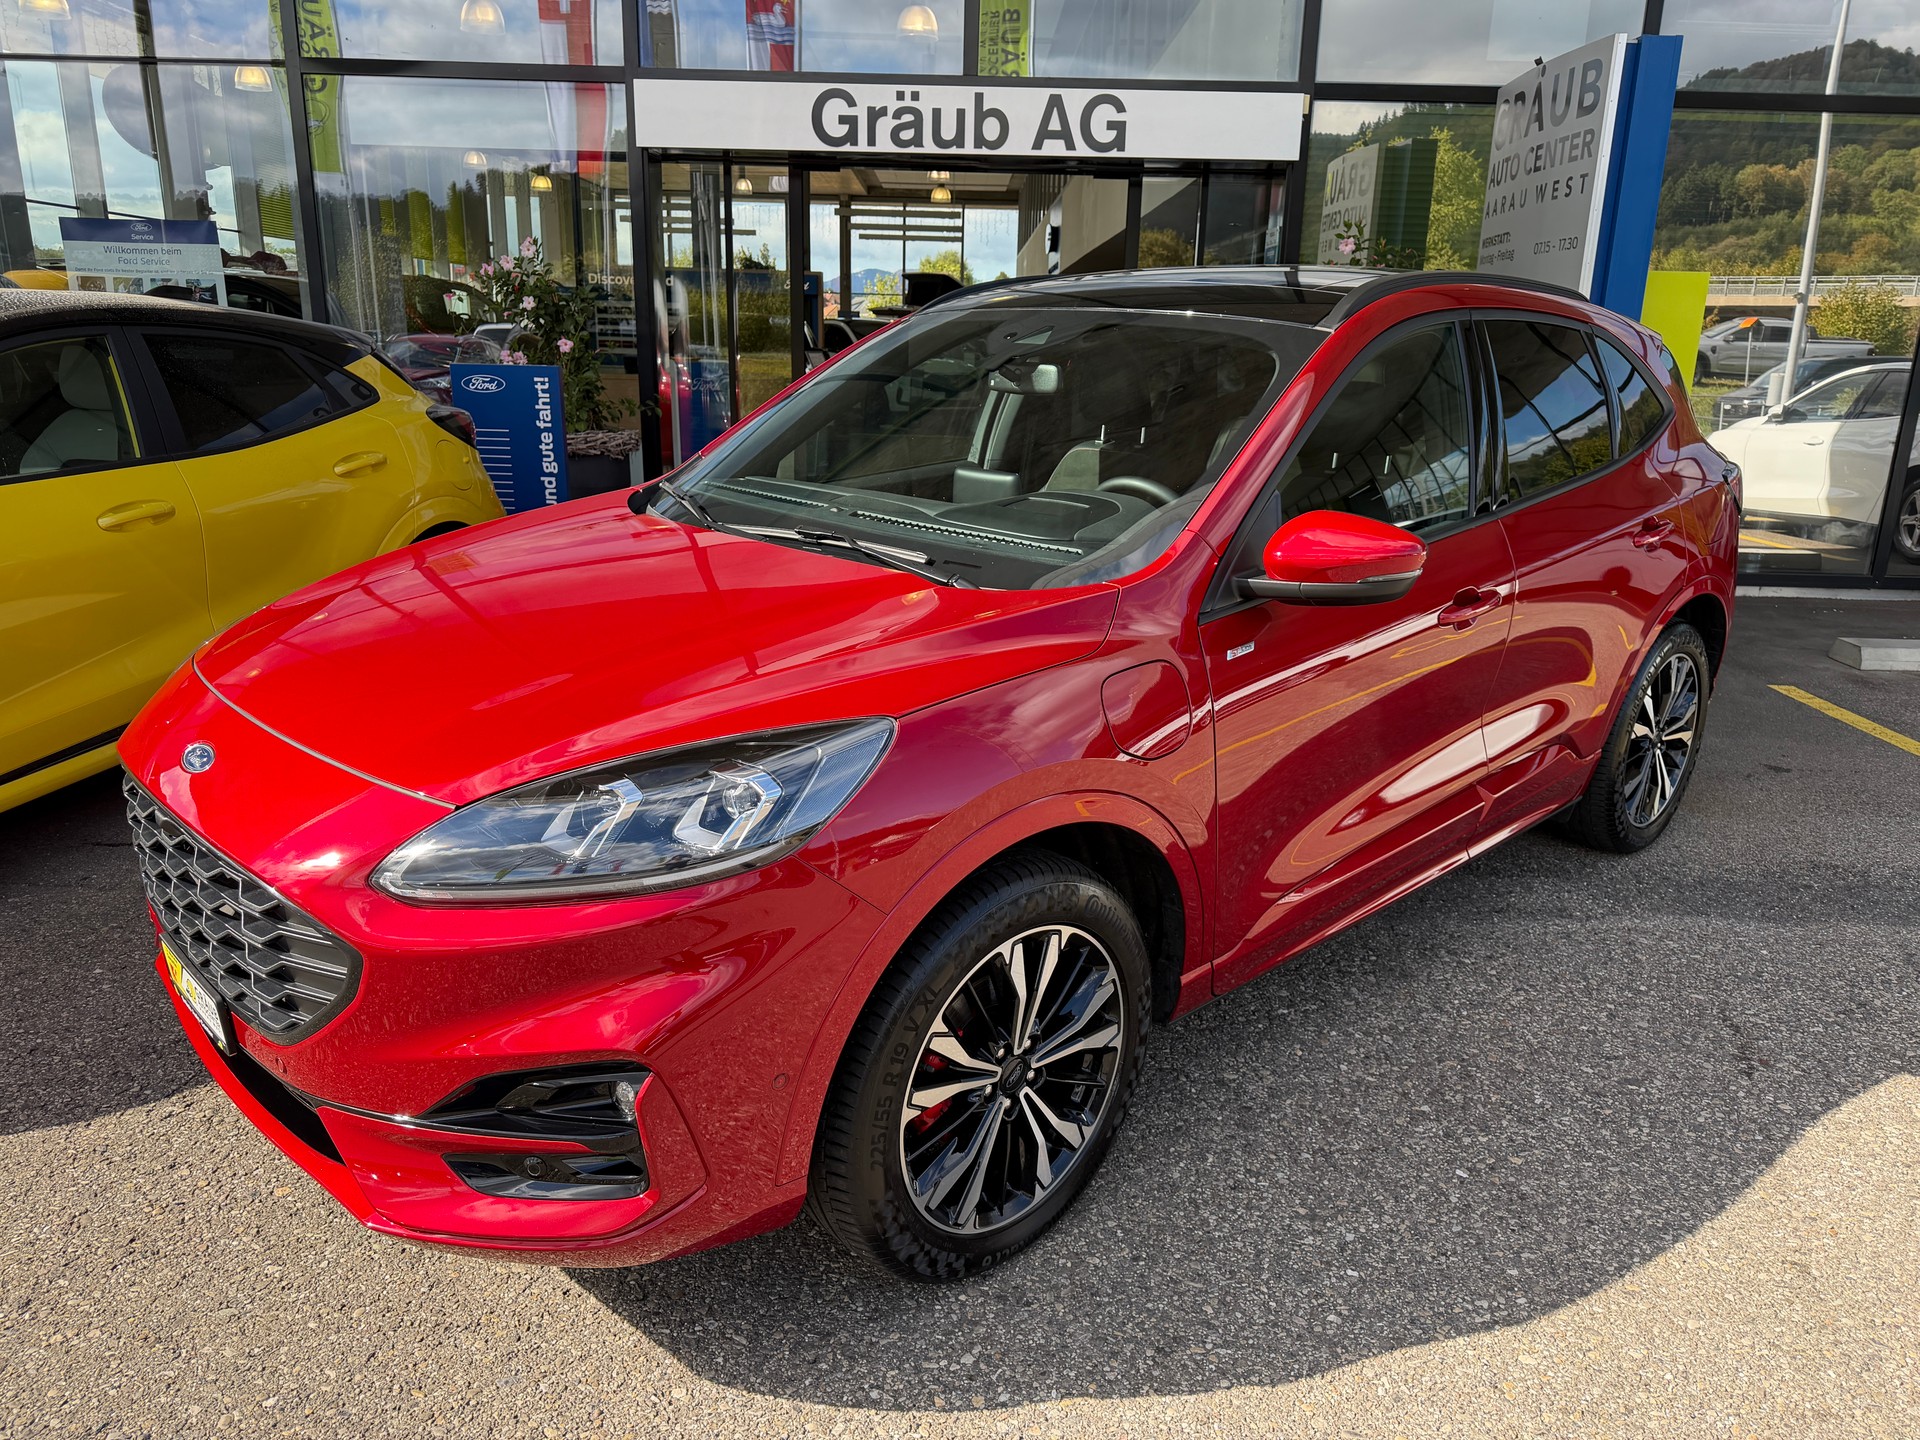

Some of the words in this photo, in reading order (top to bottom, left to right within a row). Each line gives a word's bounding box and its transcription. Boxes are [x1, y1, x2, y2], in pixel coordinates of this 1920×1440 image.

[1494, 58, 1603, 151] GRÄUB
[811, 87, 1010, 150] Gräub
[1031, 93, 1127, 153] AG
[1488, 152, 1521, 190] AUTO
[1523, 128, 1596, 176] CENTER
[1484, 188, 1528, 220] AARAU
[1535, 172, 1589, 204] WEST
[131, 233, 154, 241] Service
[1482, 231, 1511, 249] WERKSTATT:
[1558, 236, 1579, 252] 17.30
[103, 245, 159, 255] Willkommen
[161, 246, 182, 256] beim
[117, 256, 138, 265] Ford
[140, 257, 170, 266] Service
[588, 273, 634, 285] Discove
[534, 377, 553, 429] fahrt!
[539, 432, 559, 474] gute
[916, 985, 943, 1014] XL
[903, 1014, 920, 1033] V
[890, 1042, 909, 1065] 19
[882, 1073, 899, 1087] R
[870, 1095, 894, 1171] 225/55
